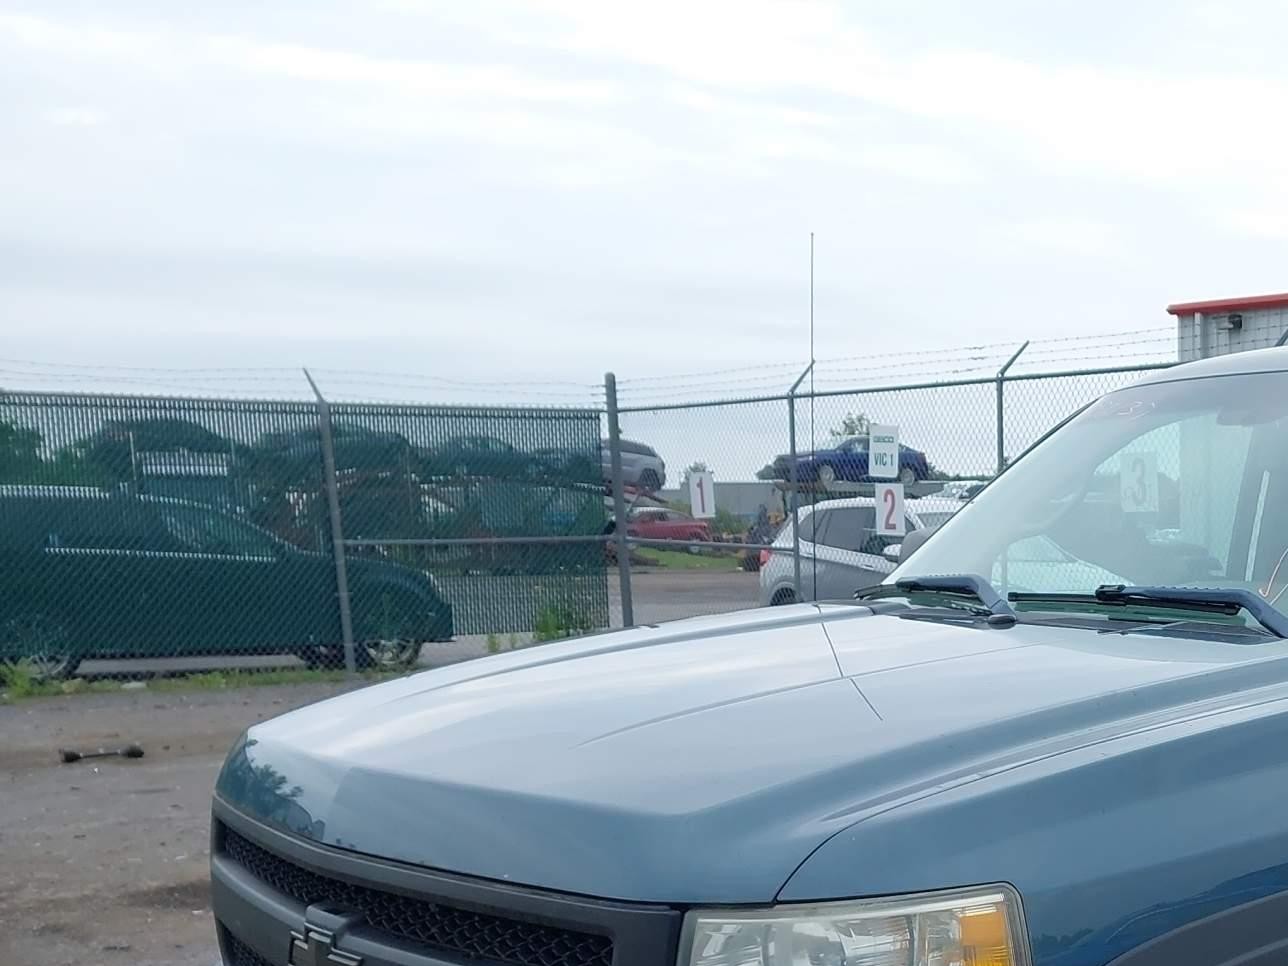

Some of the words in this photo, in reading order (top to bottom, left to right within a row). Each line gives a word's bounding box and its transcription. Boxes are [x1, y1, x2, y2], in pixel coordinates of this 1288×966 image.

[874, 452, 887, 466] VIC
[696, 476, 705, 513] 1
[883, 489, 897, 530] 2
